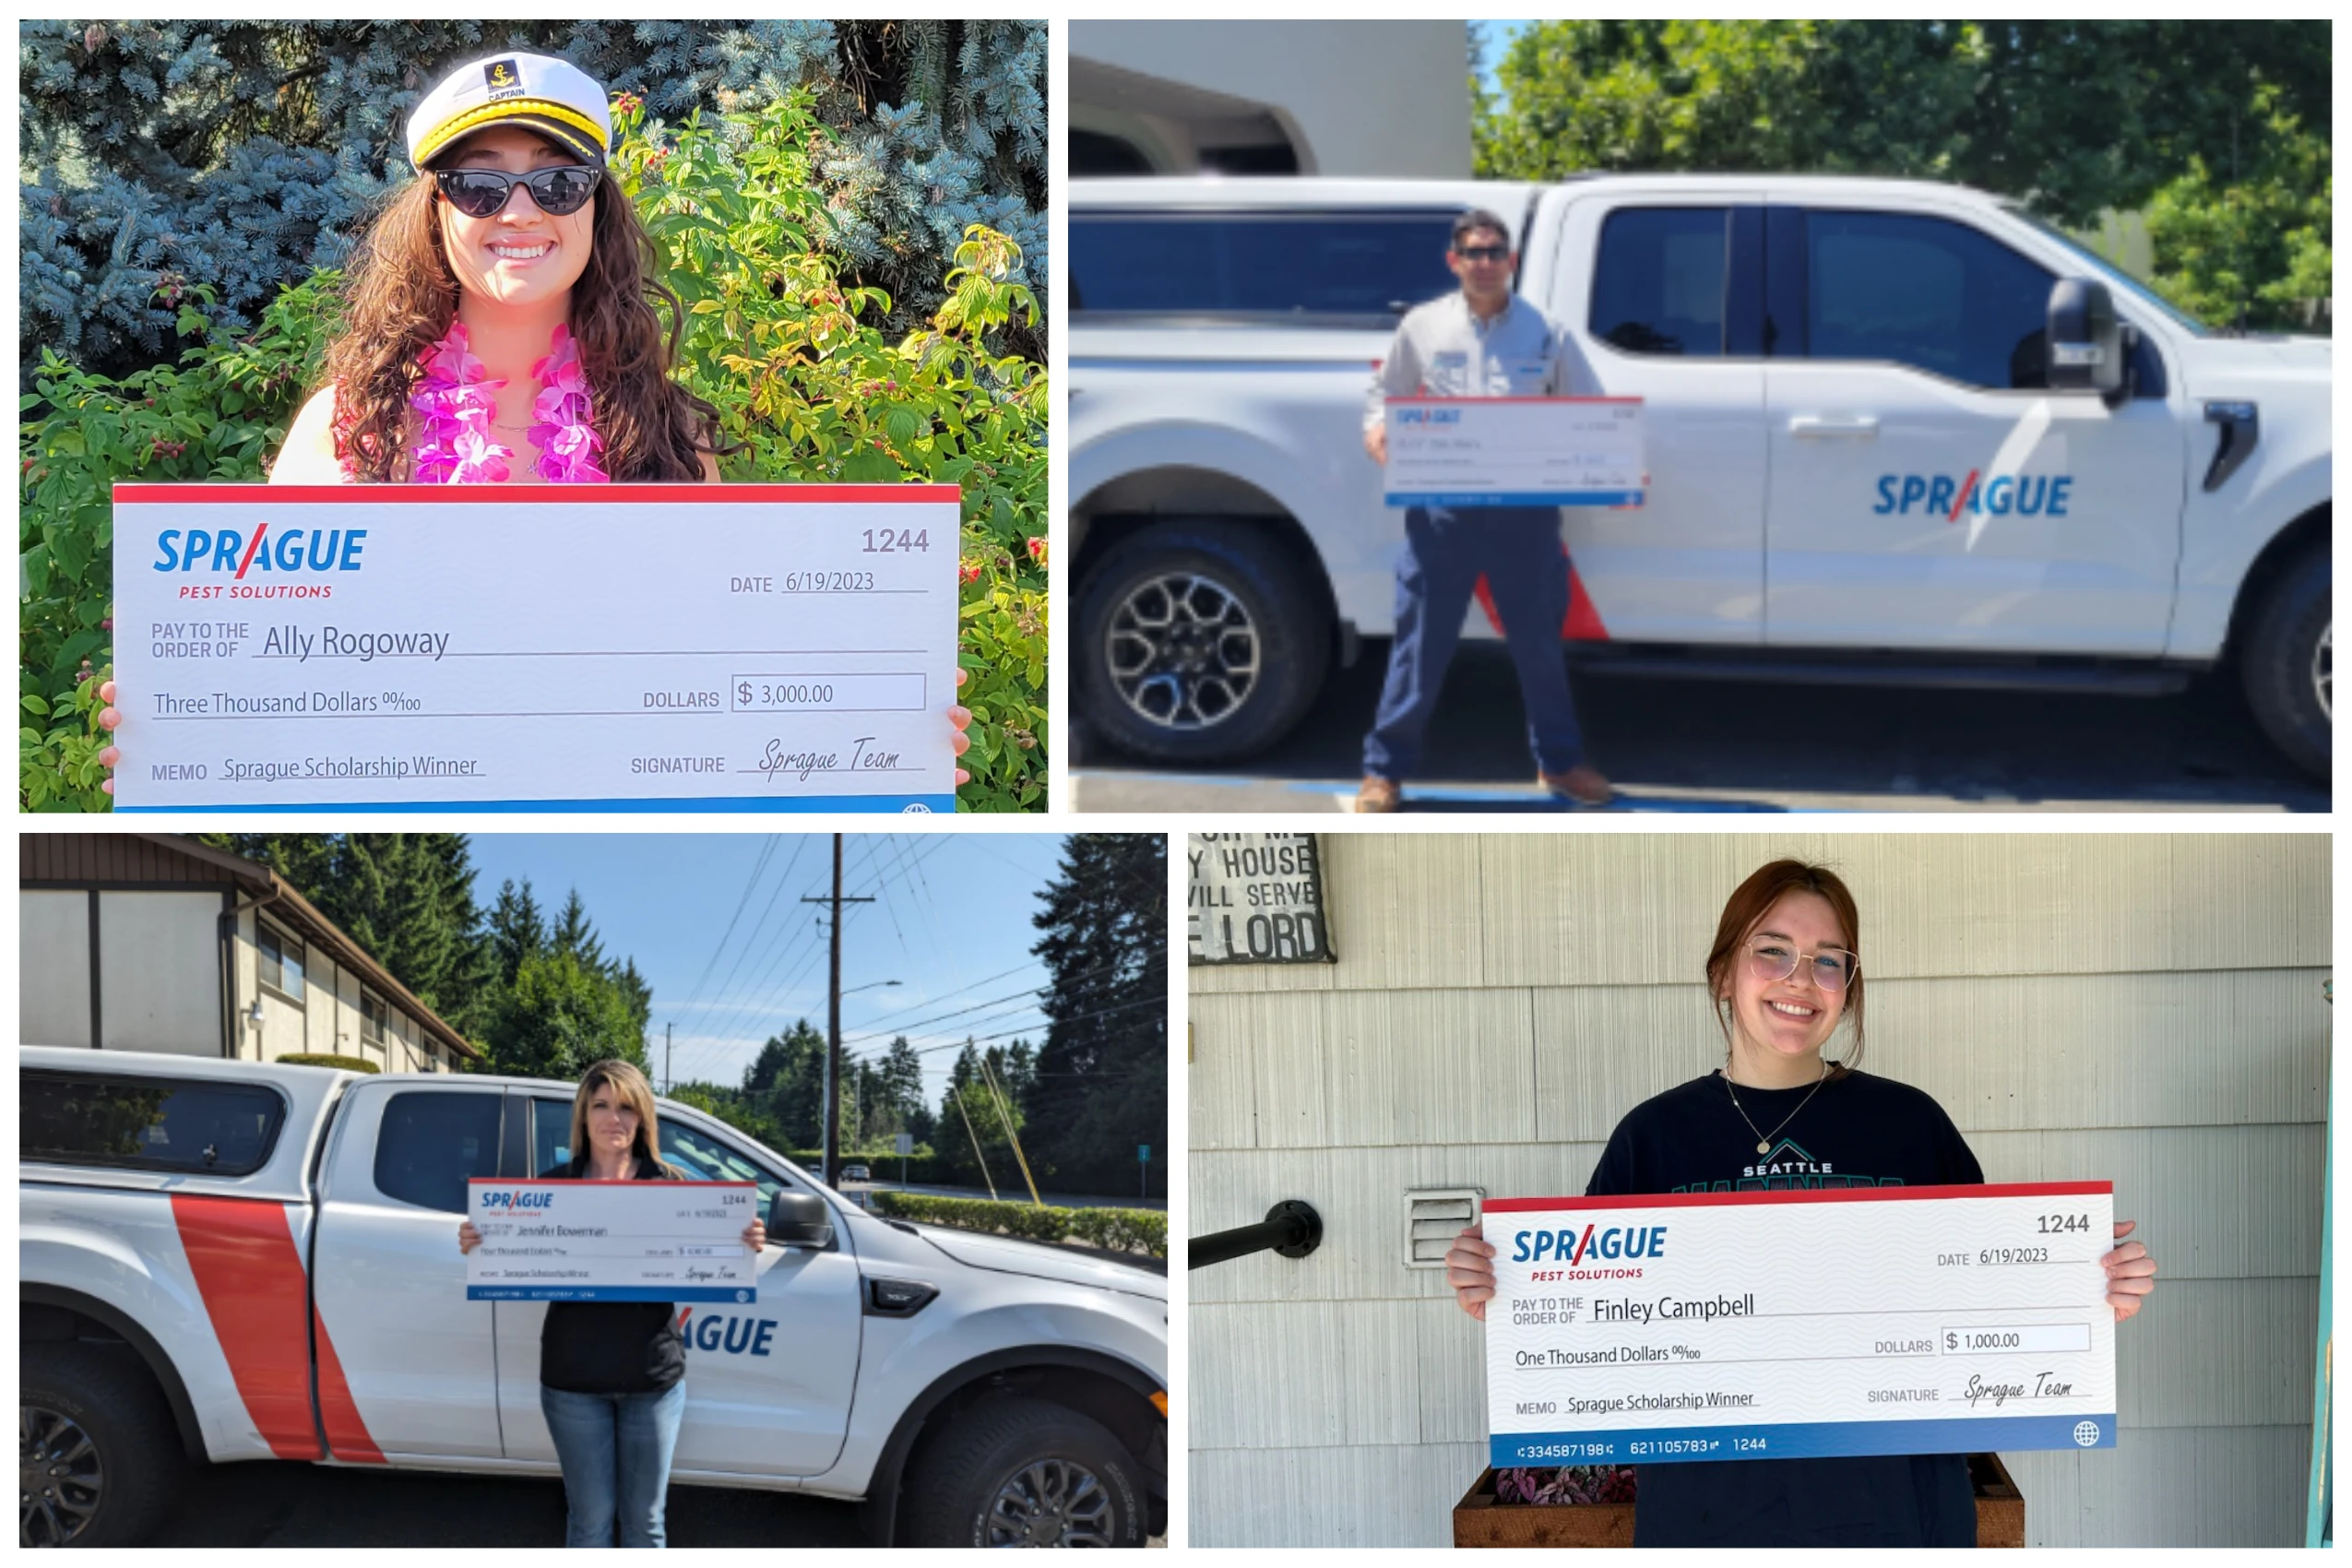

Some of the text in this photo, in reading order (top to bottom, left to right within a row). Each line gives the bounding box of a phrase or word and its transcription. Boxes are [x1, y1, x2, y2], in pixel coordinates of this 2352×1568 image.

[489, 89, 525, 102] CAPTAIN
[1873, 467, 2073, 523] SPRAGUE
[153, 523, 367, 579] SPRAGUE
[861, 529, 930, 552] 1244
[179, 586, 332, 599] PEST SOLUTIONS
[731, 572, 874, 593] DATE 6/19/2023
[151, 623, 250, 638] PAY TO THE
[151, 642, 238, 658] ORDER OF
[264, 625, 450, 662] Ally Rogoway
[153, 694, 208, 714] Three
[212, 692, 306, 713] Thousand
[313, 691, 377, 712] Dollars
[643, 681, 834, 708] DOLLARS $ 3,000.00
[151, 756, 478, 781] MEMO Sprague Scholarship Winner
[631, 737, 899, 783] SIGNATURE Sprague Team
[1222, 846, 1312, 878] HOUSE
[1247, 882, 1316, 906] SERVE
[1222, 912, 1325, 961] LORD
[1743, 1162, 1833, 1177] SEATTLE
[481, 1191, 553, 1210] SPRAGUE
[722, 1194, 746, 1205] 1244
[517, 1224, 554, 1237] Jennifer
[557, 1226, 608, 1237] Bowerman
[2037, 1215, 2090, 1234] 1244
[1512, 1224, 1668, 1266] SPRAGUE
[1937, 1248, 2049, 1266] DATE 6/19/2023
[1531, 1268, 1643, 1282] PEST SOLUTIONS
[1513, 1298, 1584, 1312] PAY TO THE
[1594, 1293, 1753, 1324] Finley Campbell
[1513, 1311, 1576, 1325] ORDER OF
[1874, 1332, 2020, 1354] DOLLARS $ 1,000.00
[1515, 1350, 1545, 1366] One
[1548, 1348, 1617, 1365] Thousand
[1621, 1346, 1669, 1362] Dollars
[1868, 1372, 2073, 1408] SIGNATURE Sprague Team
[1515, 1392, 1753, 1415] MEMO Sprague Scholarship Winner
[1733, 1438, 1766, 1451] 1244
